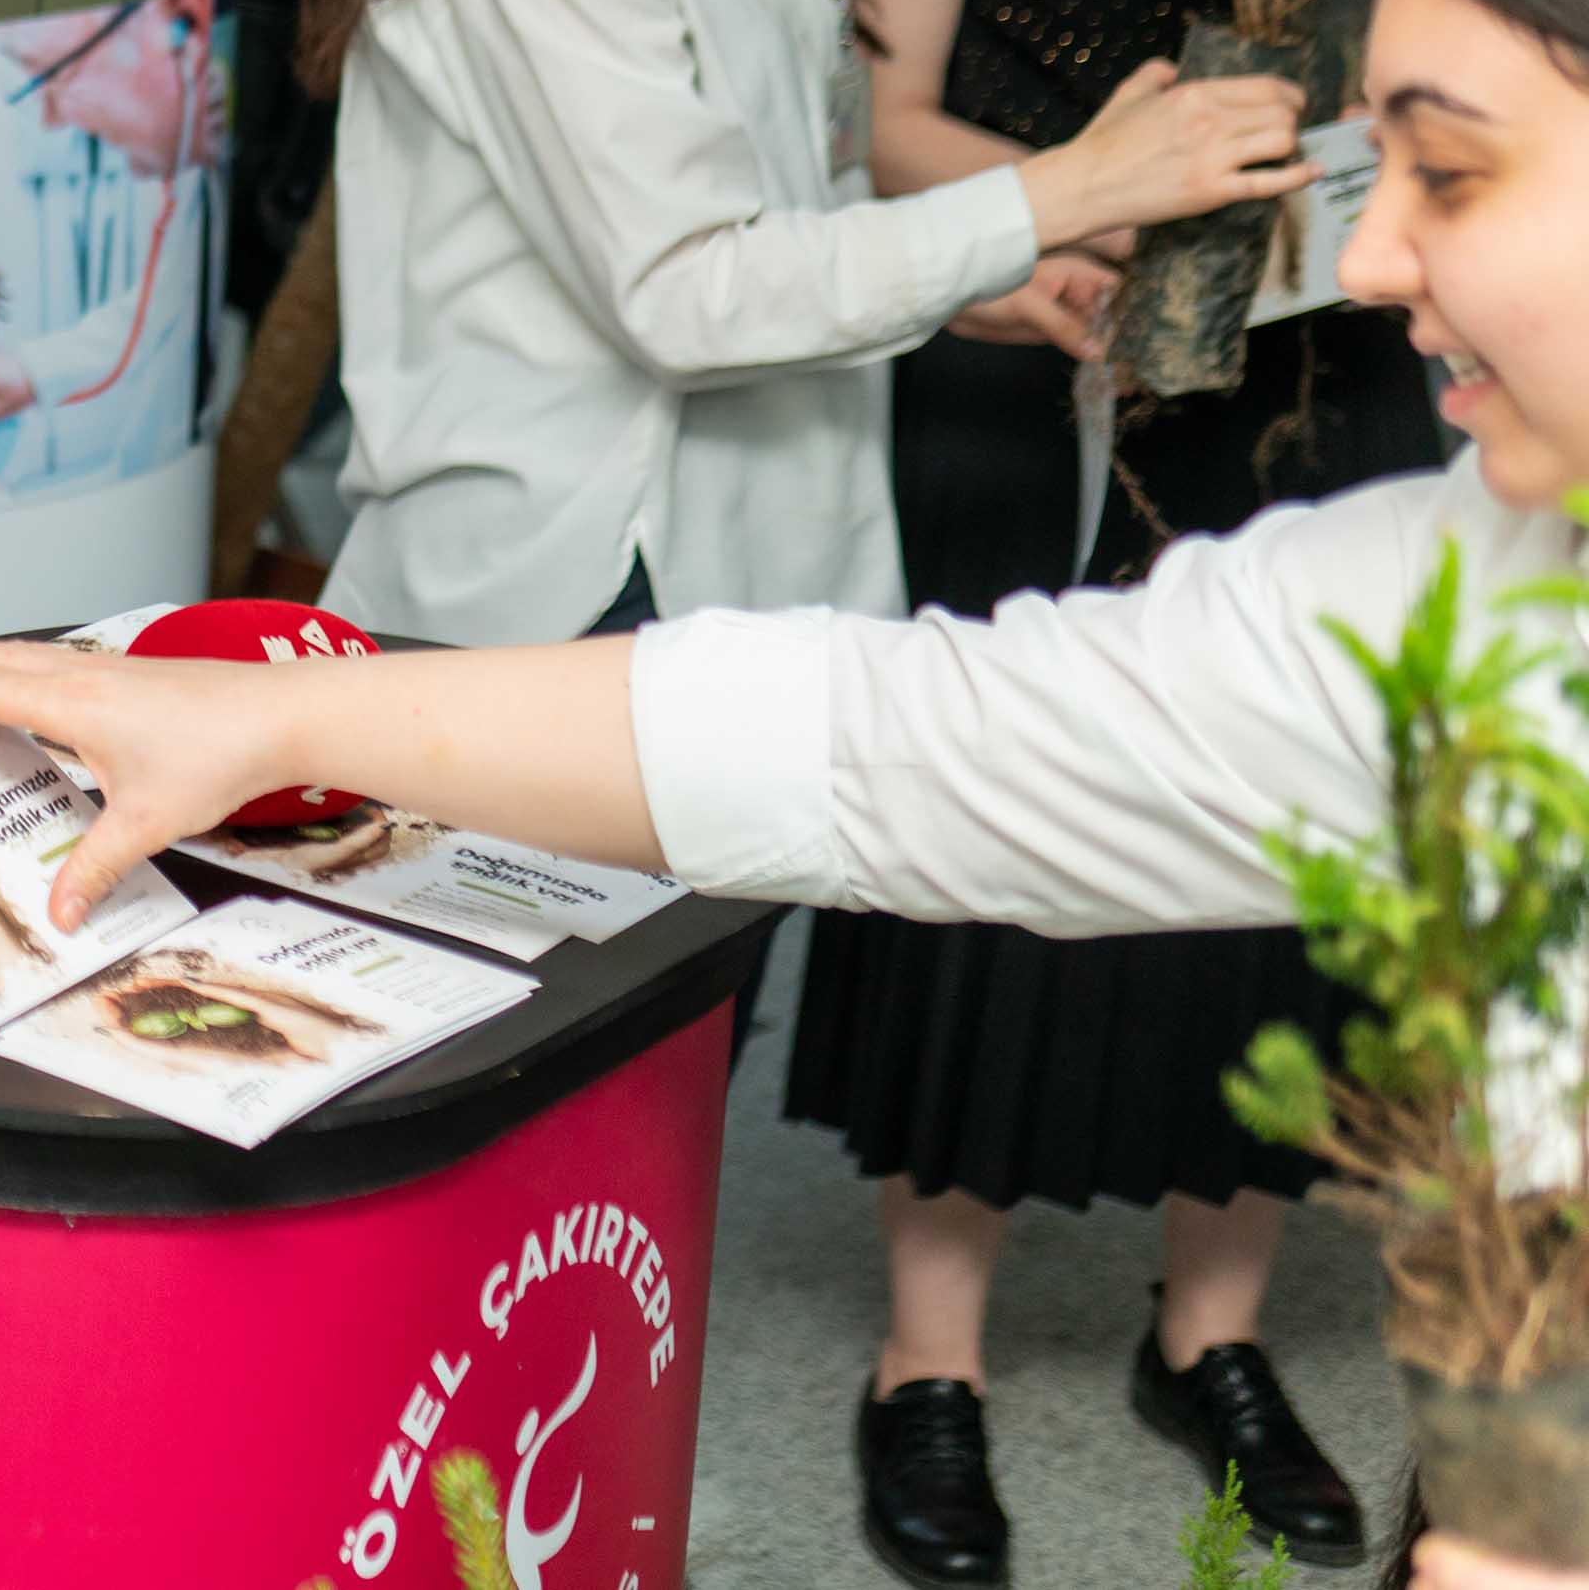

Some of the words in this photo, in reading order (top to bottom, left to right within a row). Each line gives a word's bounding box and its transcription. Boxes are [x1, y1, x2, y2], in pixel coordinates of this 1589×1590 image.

[42, 793, 73, 818] var
[449, 859, 532, 891] sağlık
[536, 884, 585, 906] var
[454, 846, 609, 903] Doğamızda
[258, 924, 362, 965] Doğamızda
[338, 1349, 472, 1580] ÖZEL
[479, 1201, 677, 1389] ÇAKIRTEPE
